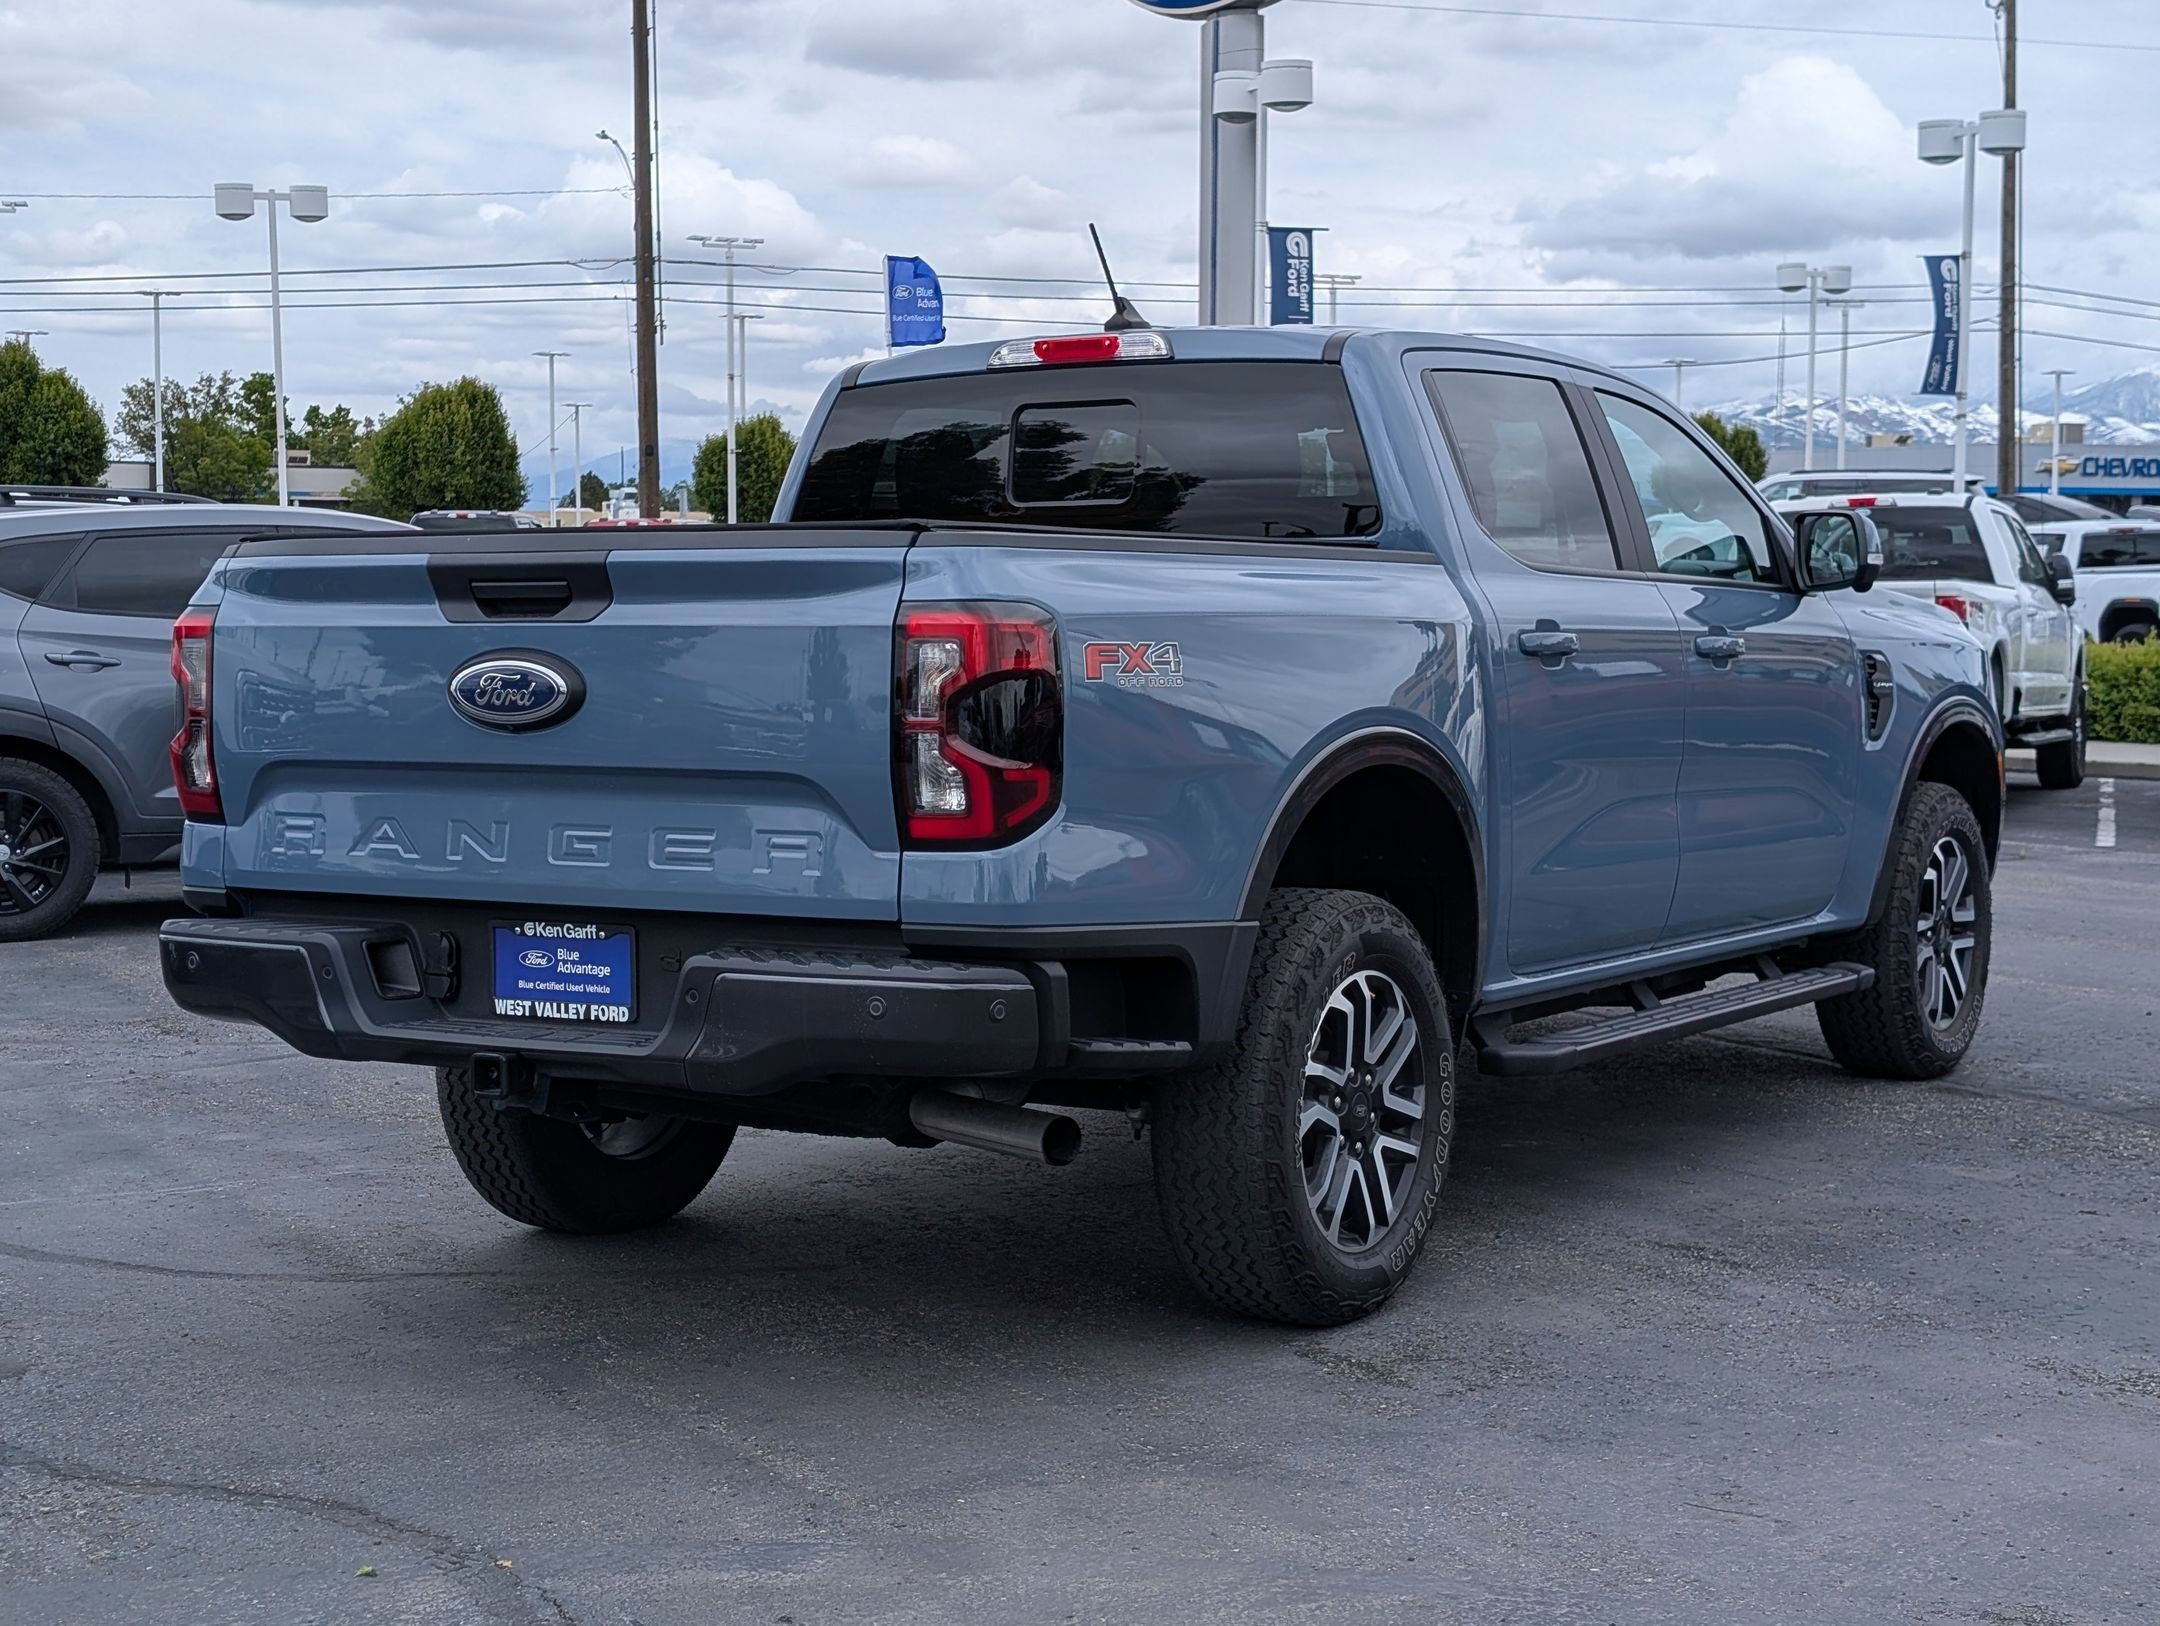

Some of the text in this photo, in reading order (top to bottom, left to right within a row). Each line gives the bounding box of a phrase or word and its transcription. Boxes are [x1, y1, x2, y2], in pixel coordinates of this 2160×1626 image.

[1286, 258, 1300, 297] Ford
[1299, 259, 1310, 313] Ken Garff
[916, 287, 934, 297] Blue
[1943, 283, 1953, 318] Ford
[2082, 456, 2160, 478] CHEVRO
[1083, 641, 1183, 682] FX4
[474, 672, 537, 707] Ford
[1118, 676, 1184, 688] OFF ROAD
[266, 810, 825, 878] RANGER
[536, 922, 563, 938] Ken
[564, 923, 598, 940] Garff
[525, 952, 548, 966] Ford
[557, 948, 580, 961] Blue
[557, 961, 611, 978] Advantage
[518, 979, 611, 995] Blue Certified Used Vehicle
[494, 998, 629, 1023] WEST VALLEY FORD
[1391, 1052, 1452, 1272] GOODYEAR
